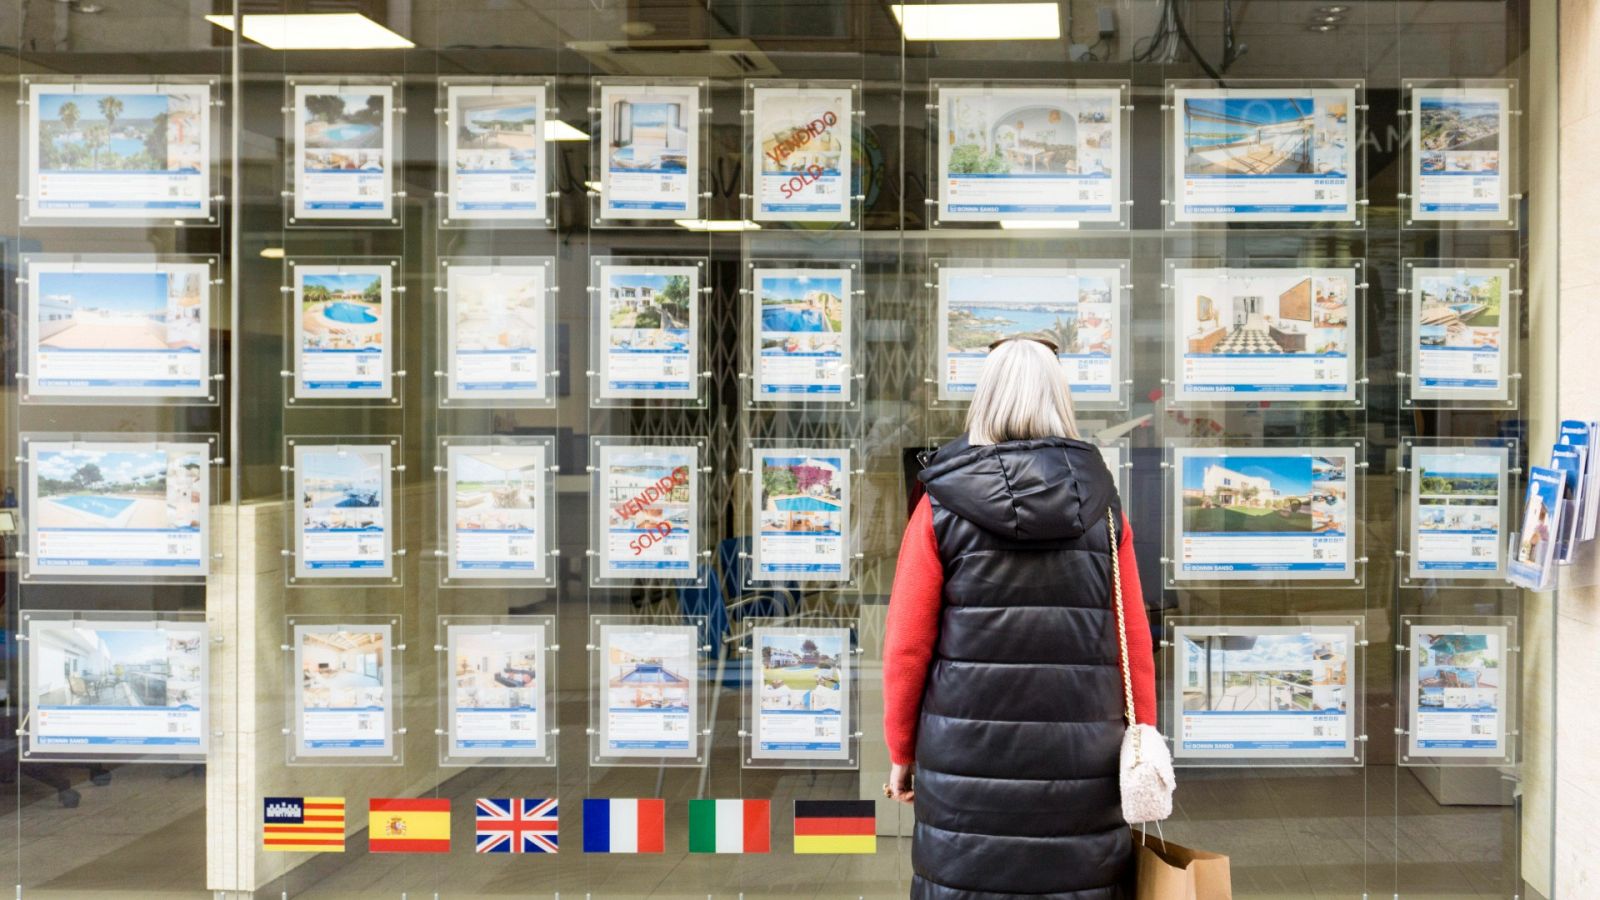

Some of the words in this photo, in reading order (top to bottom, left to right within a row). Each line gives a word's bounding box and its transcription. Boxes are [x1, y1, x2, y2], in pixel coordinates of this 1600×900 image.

[766, 111, 837, 165] VENDIDO
[780, 163, 823, 199] SOLD
[615, 467, 688, 521] VENDIDO
[629, 520, 672, 556] SOLD
